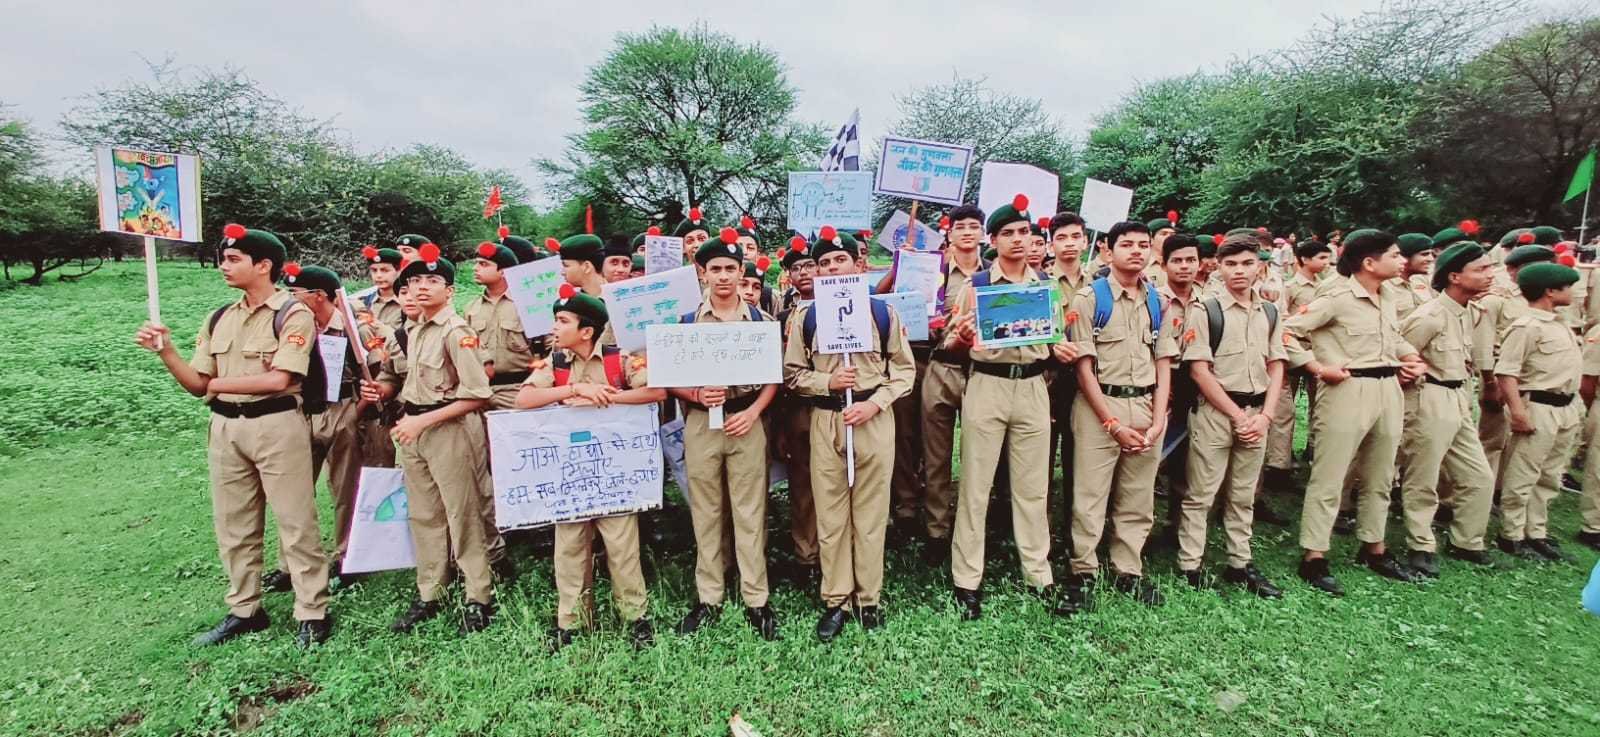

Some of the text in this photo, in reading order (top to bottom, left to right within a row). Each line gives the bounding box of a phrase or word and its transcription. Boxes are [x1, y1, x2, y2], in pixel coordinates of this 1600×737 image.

[821, 276, 860, 286] SAVE WATER
[827, 343, 843, 351] SAVE
[512, 436, 560, 472] आओ
